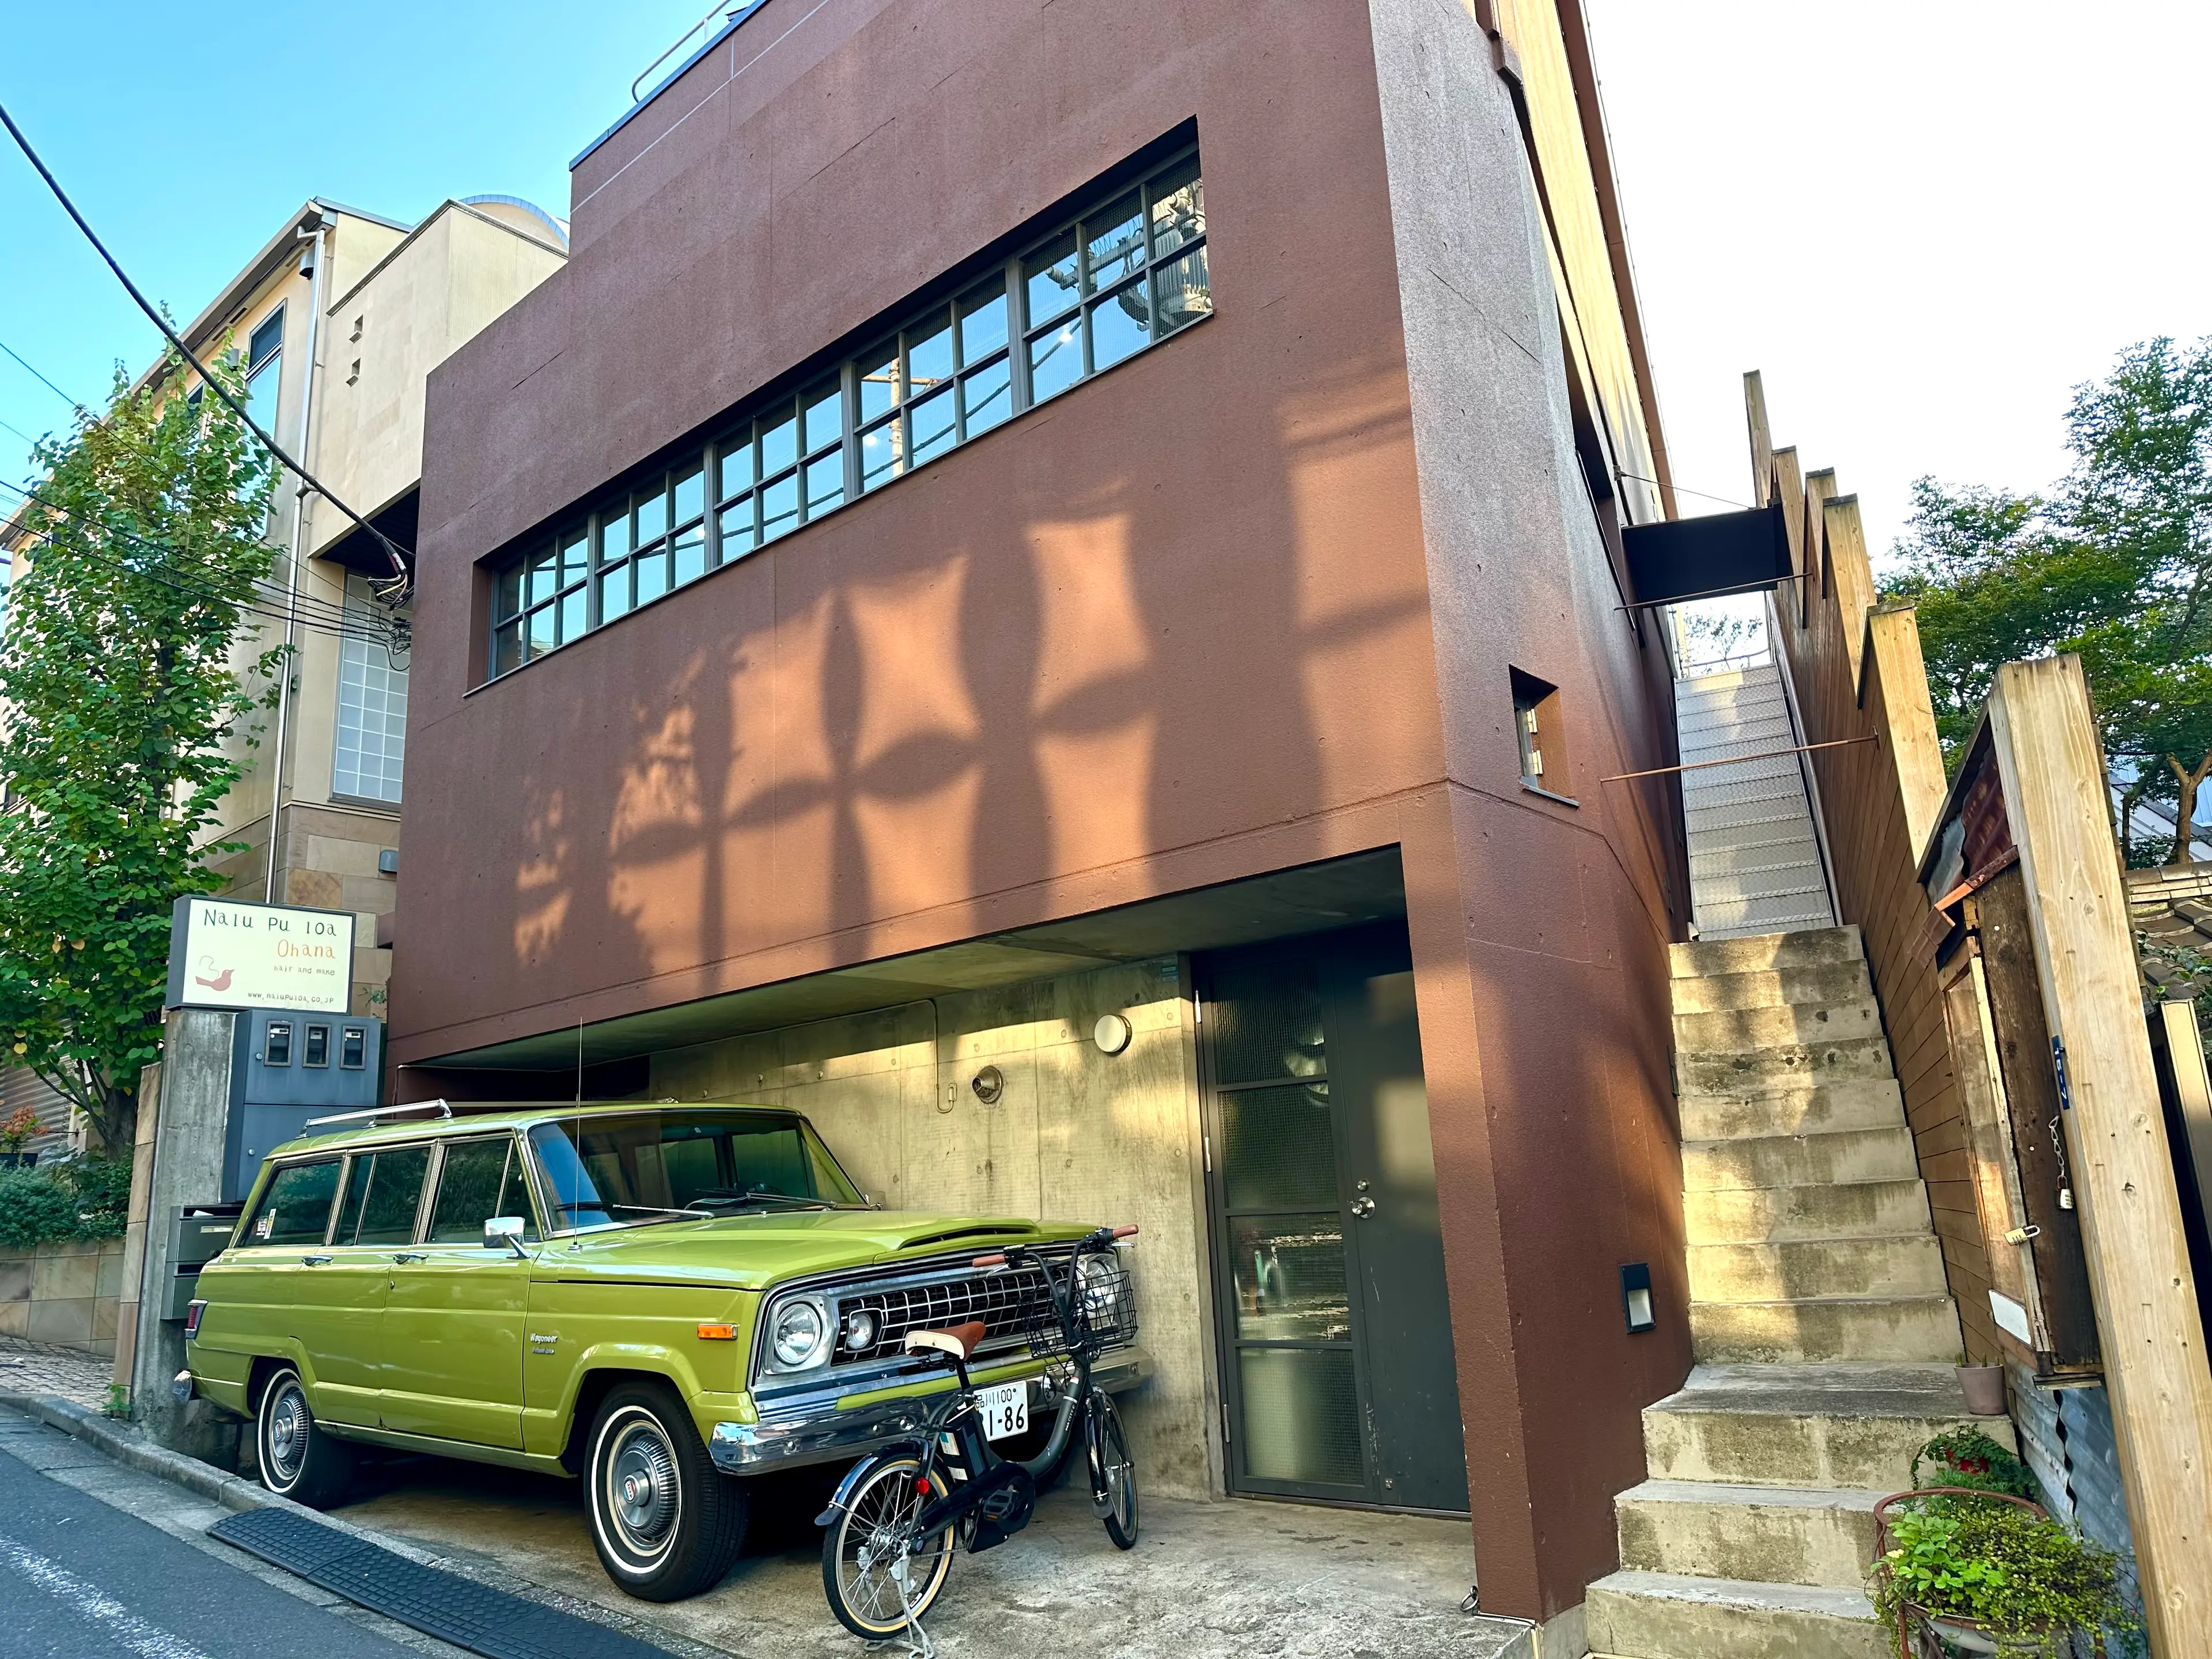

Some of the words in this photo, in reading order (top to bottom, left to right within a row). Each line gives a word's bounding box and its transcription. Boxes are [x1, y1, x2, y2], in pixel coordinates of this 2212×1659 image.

[204, 909, 253, 928] Nalu
[278, 939, 336, 959] Ohana
[530, 1332, 558, 1344] Wagoneer
[979, 1403, 1024, 1436] 1-86
